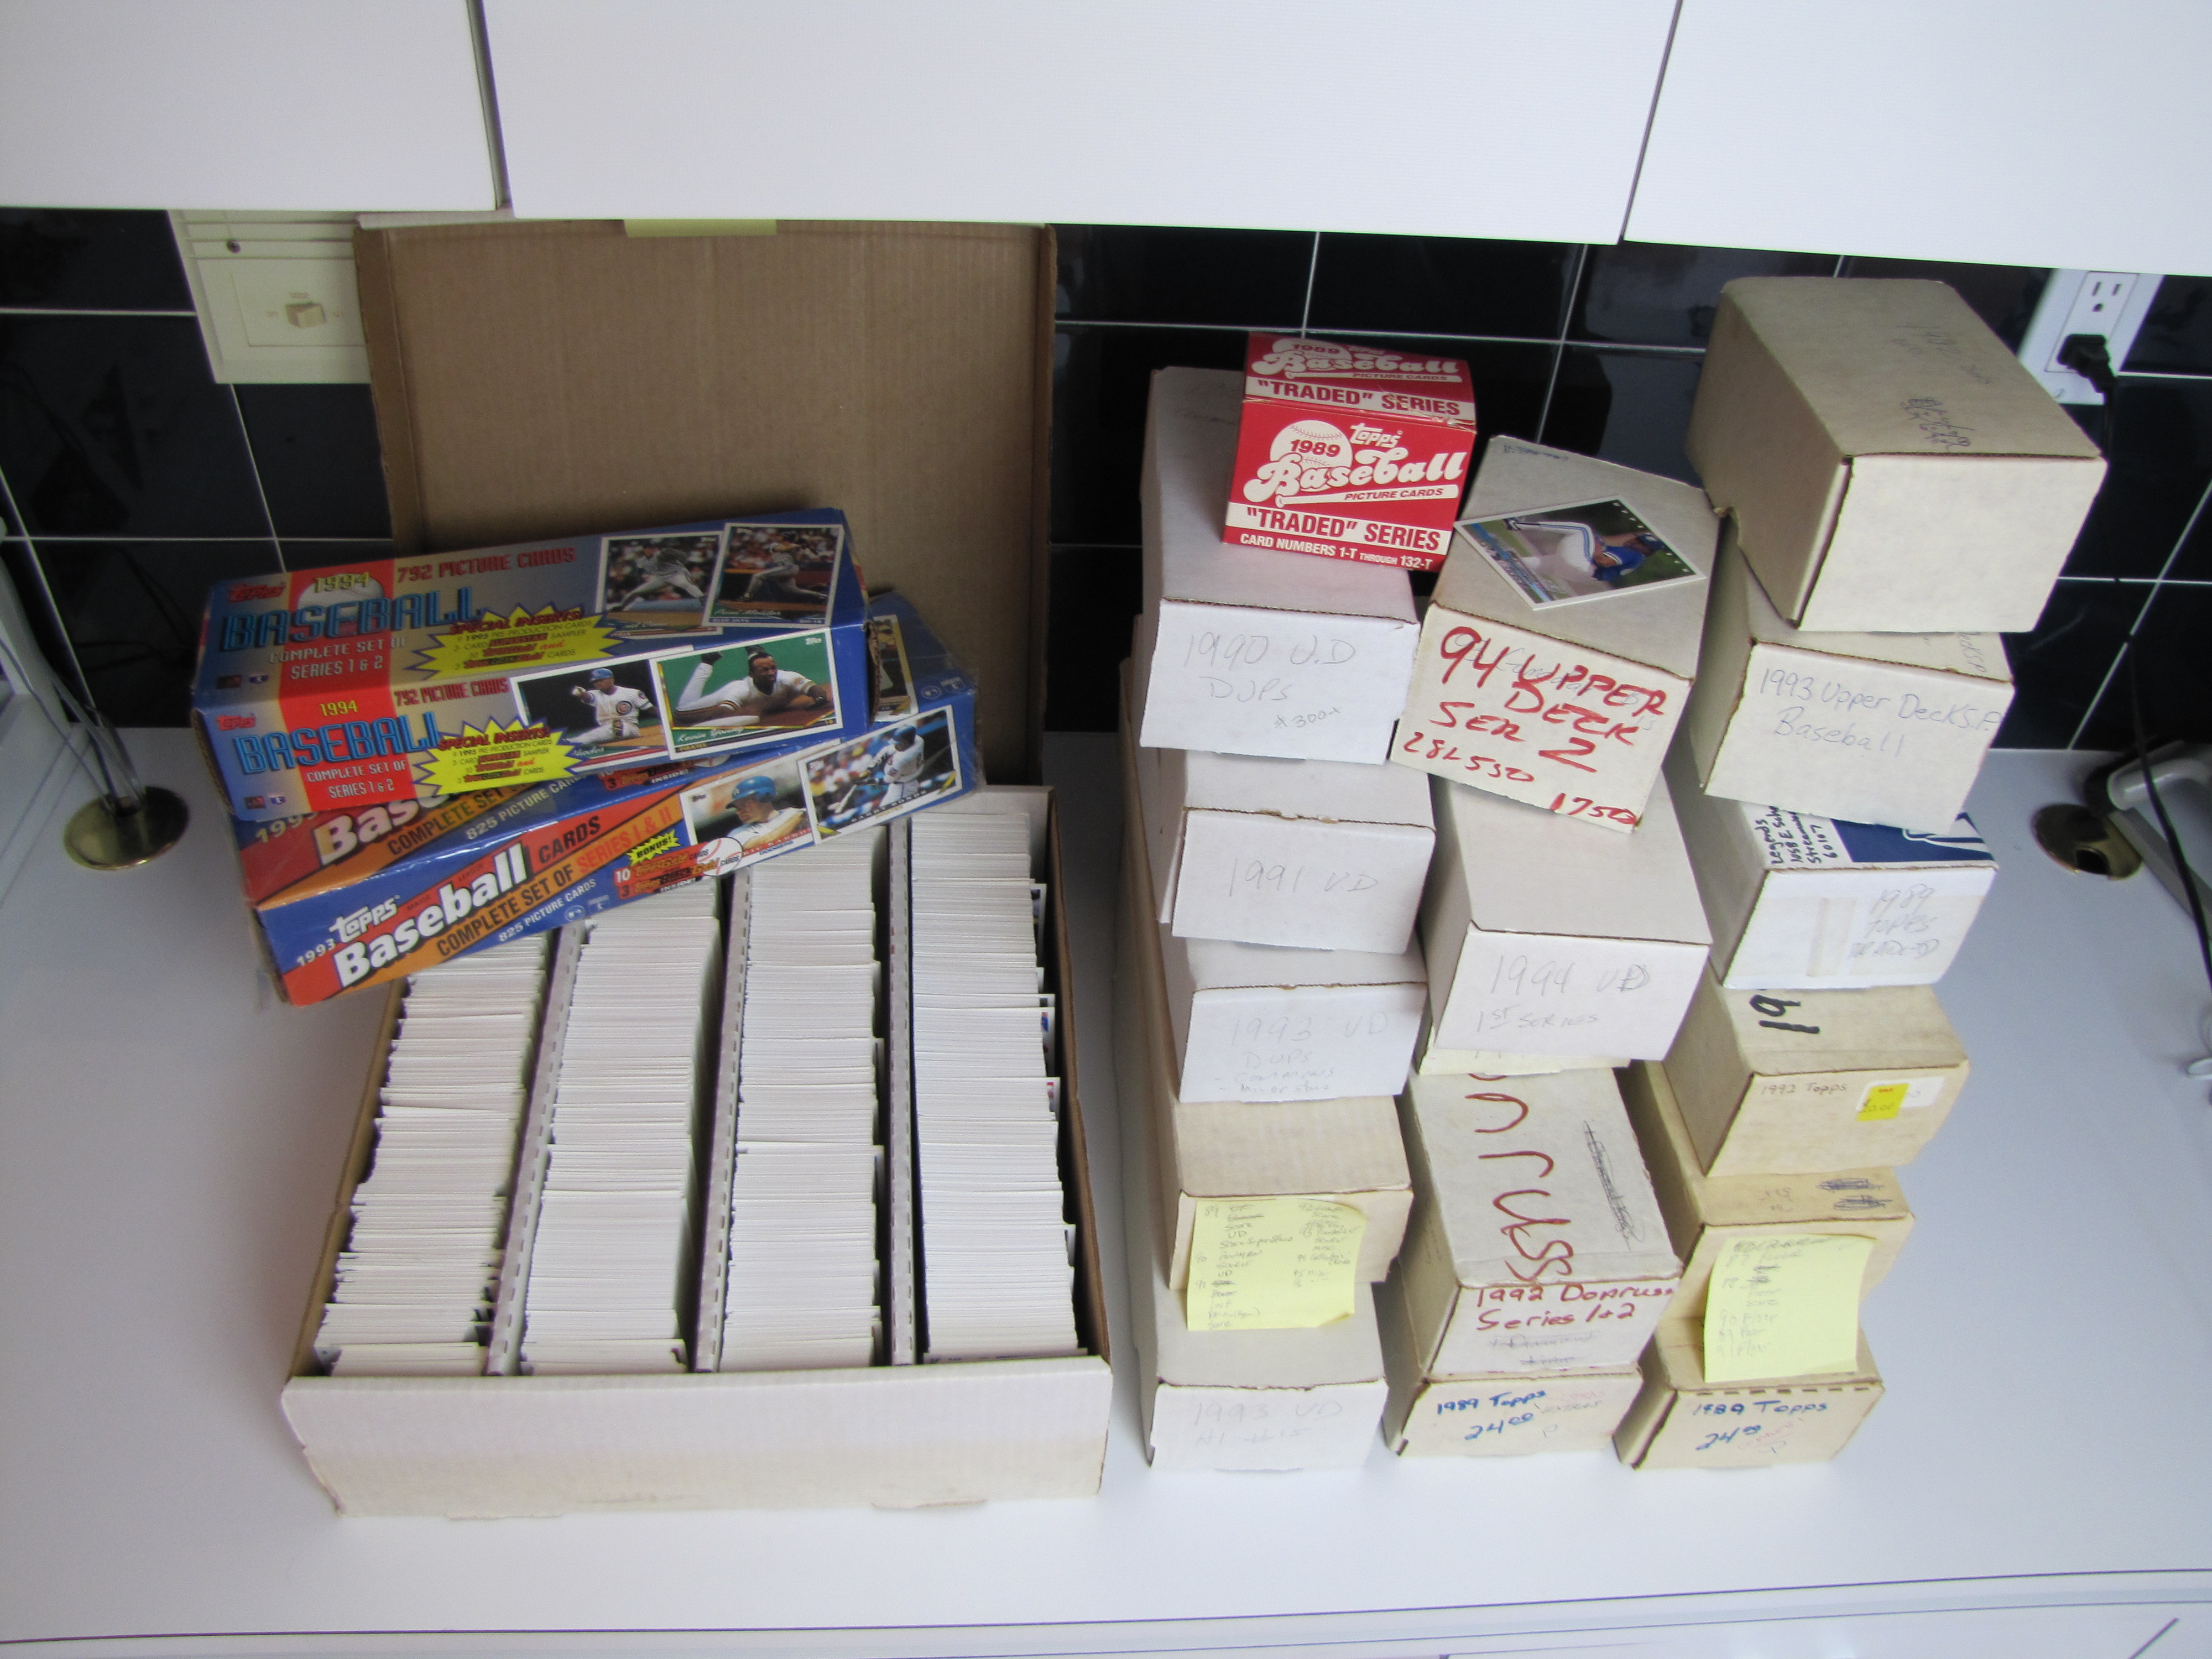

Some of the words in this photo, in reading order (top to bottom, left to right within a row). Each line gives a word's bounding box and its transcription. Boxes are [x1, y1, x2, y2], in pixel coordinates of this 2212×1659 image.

[1251, 351, 1459, 375] Baseball
[1292, 343, 1341, 354] 1989
[1381, 393, 1460, 416] SERIES
[1290, 439, 1341, 458] 1989
[1243, 447, 1469, 503] Baseball
[1344, 488, 1398, 501] PICTURE
[1399, 488, 1444, 499] CARDS
[1240, 533, 1274, 546] CARD
[1275, 537, 1336, 556] NUMBERS
[1339, 545, 1358, 559] 1-T
[1359, 552, 1398, 565] THROUGH
[1399, 555, 1433, 570] 132-T
[1364, 523, 1441, 551] SERIES
[396, 564, 434, 583] 792
[439, 552, 513, 579] PICTURE
[518, 546, 577, 568] CARDS
[314, 571, 371, 593] 1994
[223, 586, 482, 653] BASEBALL
[268, 642, 349, 664] COMPLETE
[356, 639, 384, 654] SET
[1183, 632, 1270, 671] 1990
[290, 660, 342, 680] SERIES
[348, 658, 354, 673] 1
[373, 655, 383, 669] 2
[1440, 626, 1510, 688] 94
[1517, 654, 1665, 717] UPPER
[394, 690, 420, 707] 792
[422, 682, 469, 703] PICTURE
[471, 677, 510, 697] CARDS
[1198, 676, 1293, 702] DUPS
[1760, 668, 1815, 701] 1993
[1820, 681, 1892, 712] Upper
[319, 700, 358, 717] 1994
[1504, 680, 1640, 746] DECK
[233, 711, 440, 775] BASEBALL
[439, 734, 491, 750] SPECIAL
[1430, 702, 1526, 743] SER
[1537, 737, 1598, 773] 2
[1773, 706, 1906, 757] Baseball
[305, 765, 366, 783] COMPLETE
[368, 761, 390, 775] SET
[392, 758, 408, 771] OF
[327, 781, 367, 800] SERIES
[370, 781, 375, 794] 1
[378, 781, 385, 792] &
[386, 779, 395, 792] 2
[387, 805, 473, 855] COMPLETE
[473, 788, 504, 810] SET
[464, 816, 498, 839] 825
[499, 790, 549, 822] PICTURE
[538, 816, 602, 865] CARDS
[636, 837, 672, 858] BONUS!
[1754, 818, 1785, 865] Legends
[1778, 830, 1794, 839] E
[1809, 824, 1839, 858] 60107
[437, 898, 523, 956] COMPLETE
[523, 877, 554, 907] SET
[555, 863, 576, 884] OF
[576, 831, 631, 869] SERIES
[643, 818, 657, 837] &
[616, 868, 632, 883] 10
[1229, 857, 1305, 897] 1991
[620, 885, 630, 897] 3
[1870, 883, 1935, 922] 1989
[333, 843, 528, 988] Baseball
[499, 922, 524, 943] 825
[525, 896, 565, 926] PICTURE
[565, 878, 597, 903] CARDS
[296, 938, 336, 968] 1993
[1490, 954, 1577, 996] 1994
[1232, 1016, 1312, 1047] 1993
[1344, 1010, 1388, 1039] UD
[1760, 1083, 1796, 1095] 1992
[1806, 1082, 1848, 1095] Topps
[1477, 1285, 1545, 1307] 1992
[1477, 1307, 1575, 1331] Series
[1195, 1401, 1269, 1426] 1993
[1295, 1400, 1343, 1421] UD
[1437, 1397, 1479, 1417] 1989
[1489, 1389, 1547, 1409] Topps
[1692, 1402, 1745, 1416] 1989
[1752, 1400, 1828, 1416] Topps
